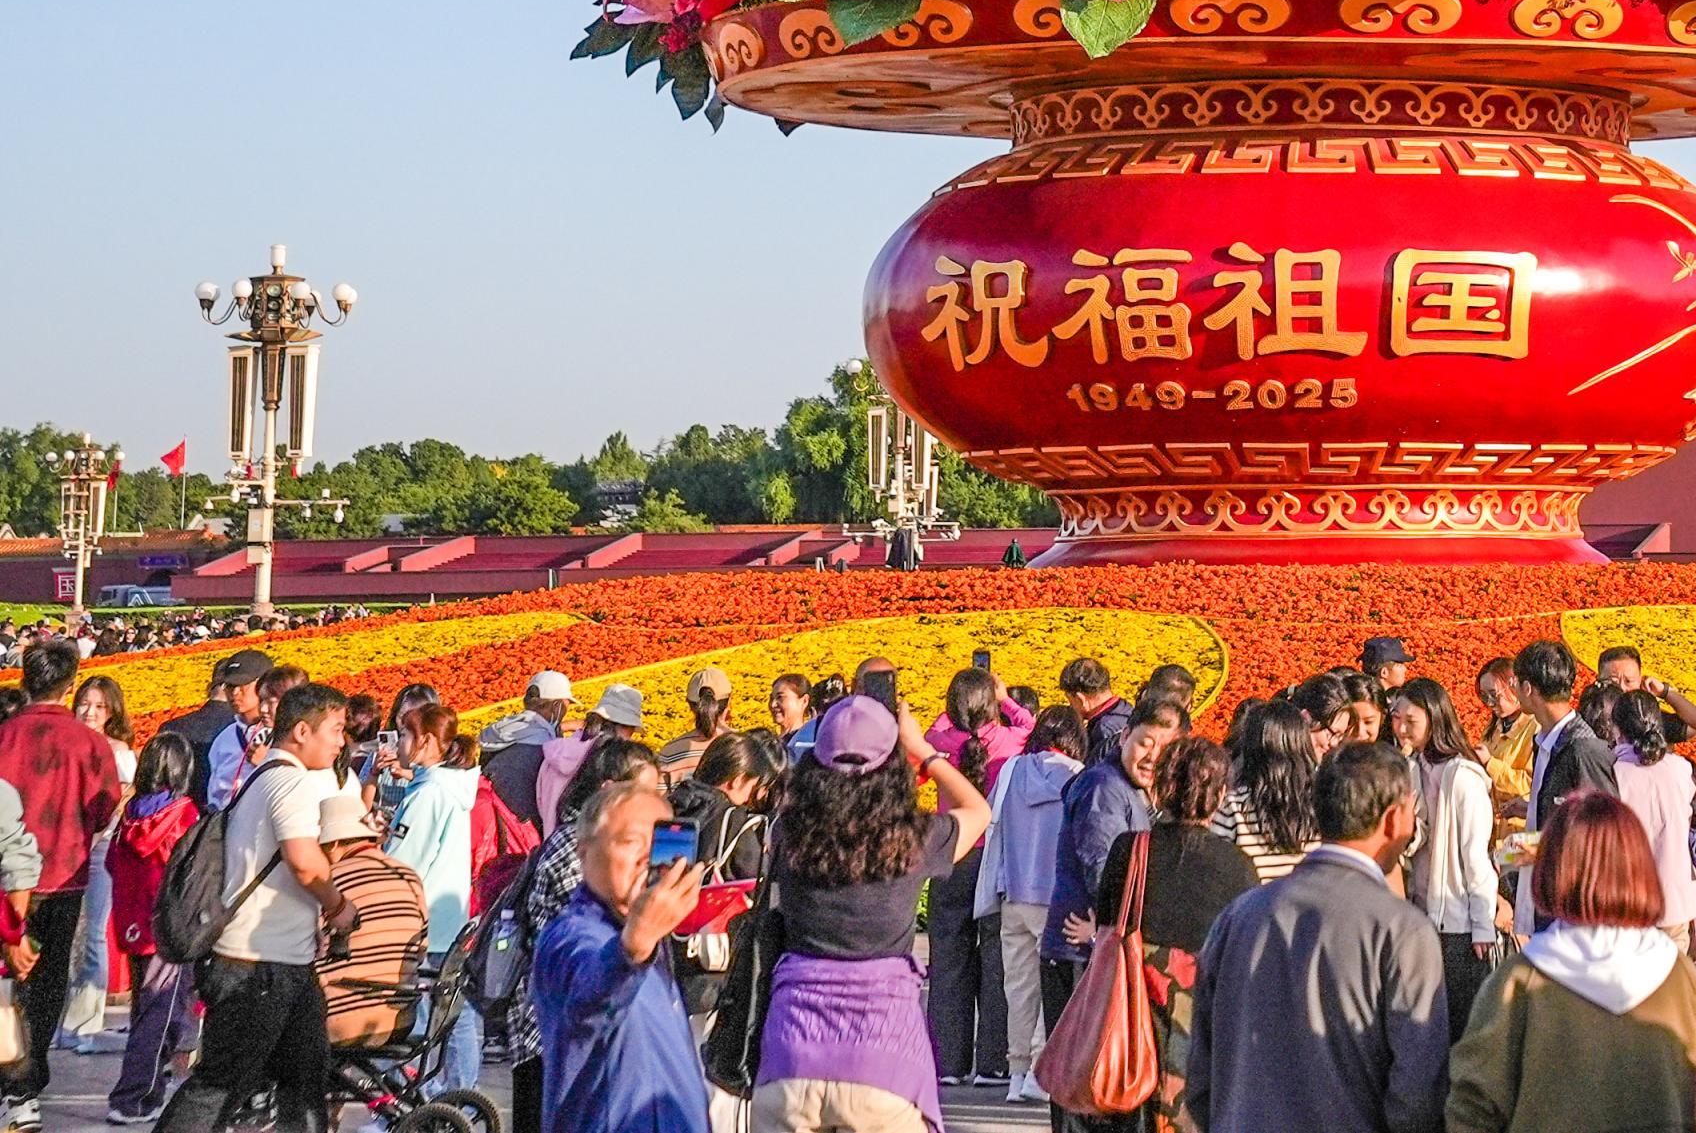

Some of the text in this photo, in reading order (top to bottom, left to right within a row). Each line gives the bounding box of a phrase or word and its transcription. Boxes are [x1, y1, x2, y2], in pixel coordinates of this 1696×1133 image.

[920, 241, 1538, 372] 祝福祖国
[1066, 378, 1358, 412] 1949-2025
